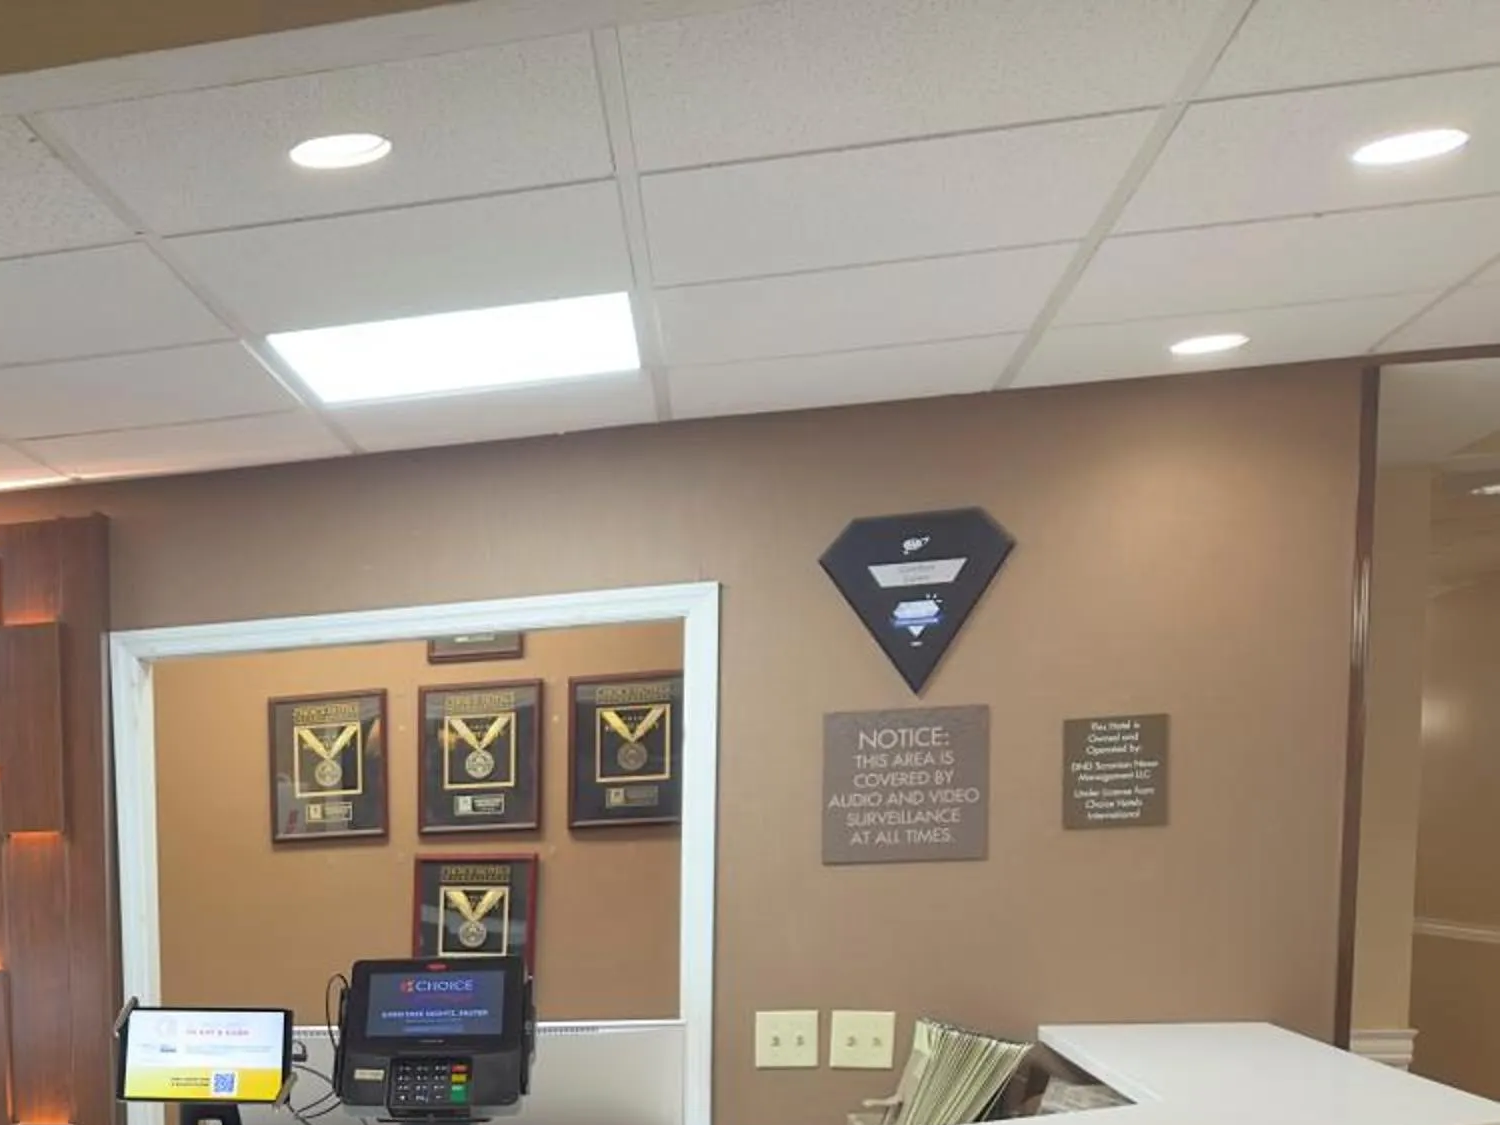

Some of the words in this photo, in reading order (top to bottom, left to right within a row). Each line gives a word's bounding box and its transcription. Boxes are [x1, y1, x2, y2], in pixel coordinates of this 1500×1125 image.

[858, 727, 950, 750] NOTICE:
[853, 753, 889, 769] THIS
[892, 751, 935, 767] AREA
[941, 750, 956, 765] IS
[853, 770, 931, 788] COVERED
[934, 769, 955, 785] BY
[828, 792, 883, 808] AUDIO
[886, 790, 925, 806] AND
[928, 787, 981, 803] VIDEO
[846, 806, 962, 827] SURVEILLANCE
[850, 831, 871, 846] AT
[874, 829, 900, 845] ALL
[415, 979, 474, 992] CHOICE
